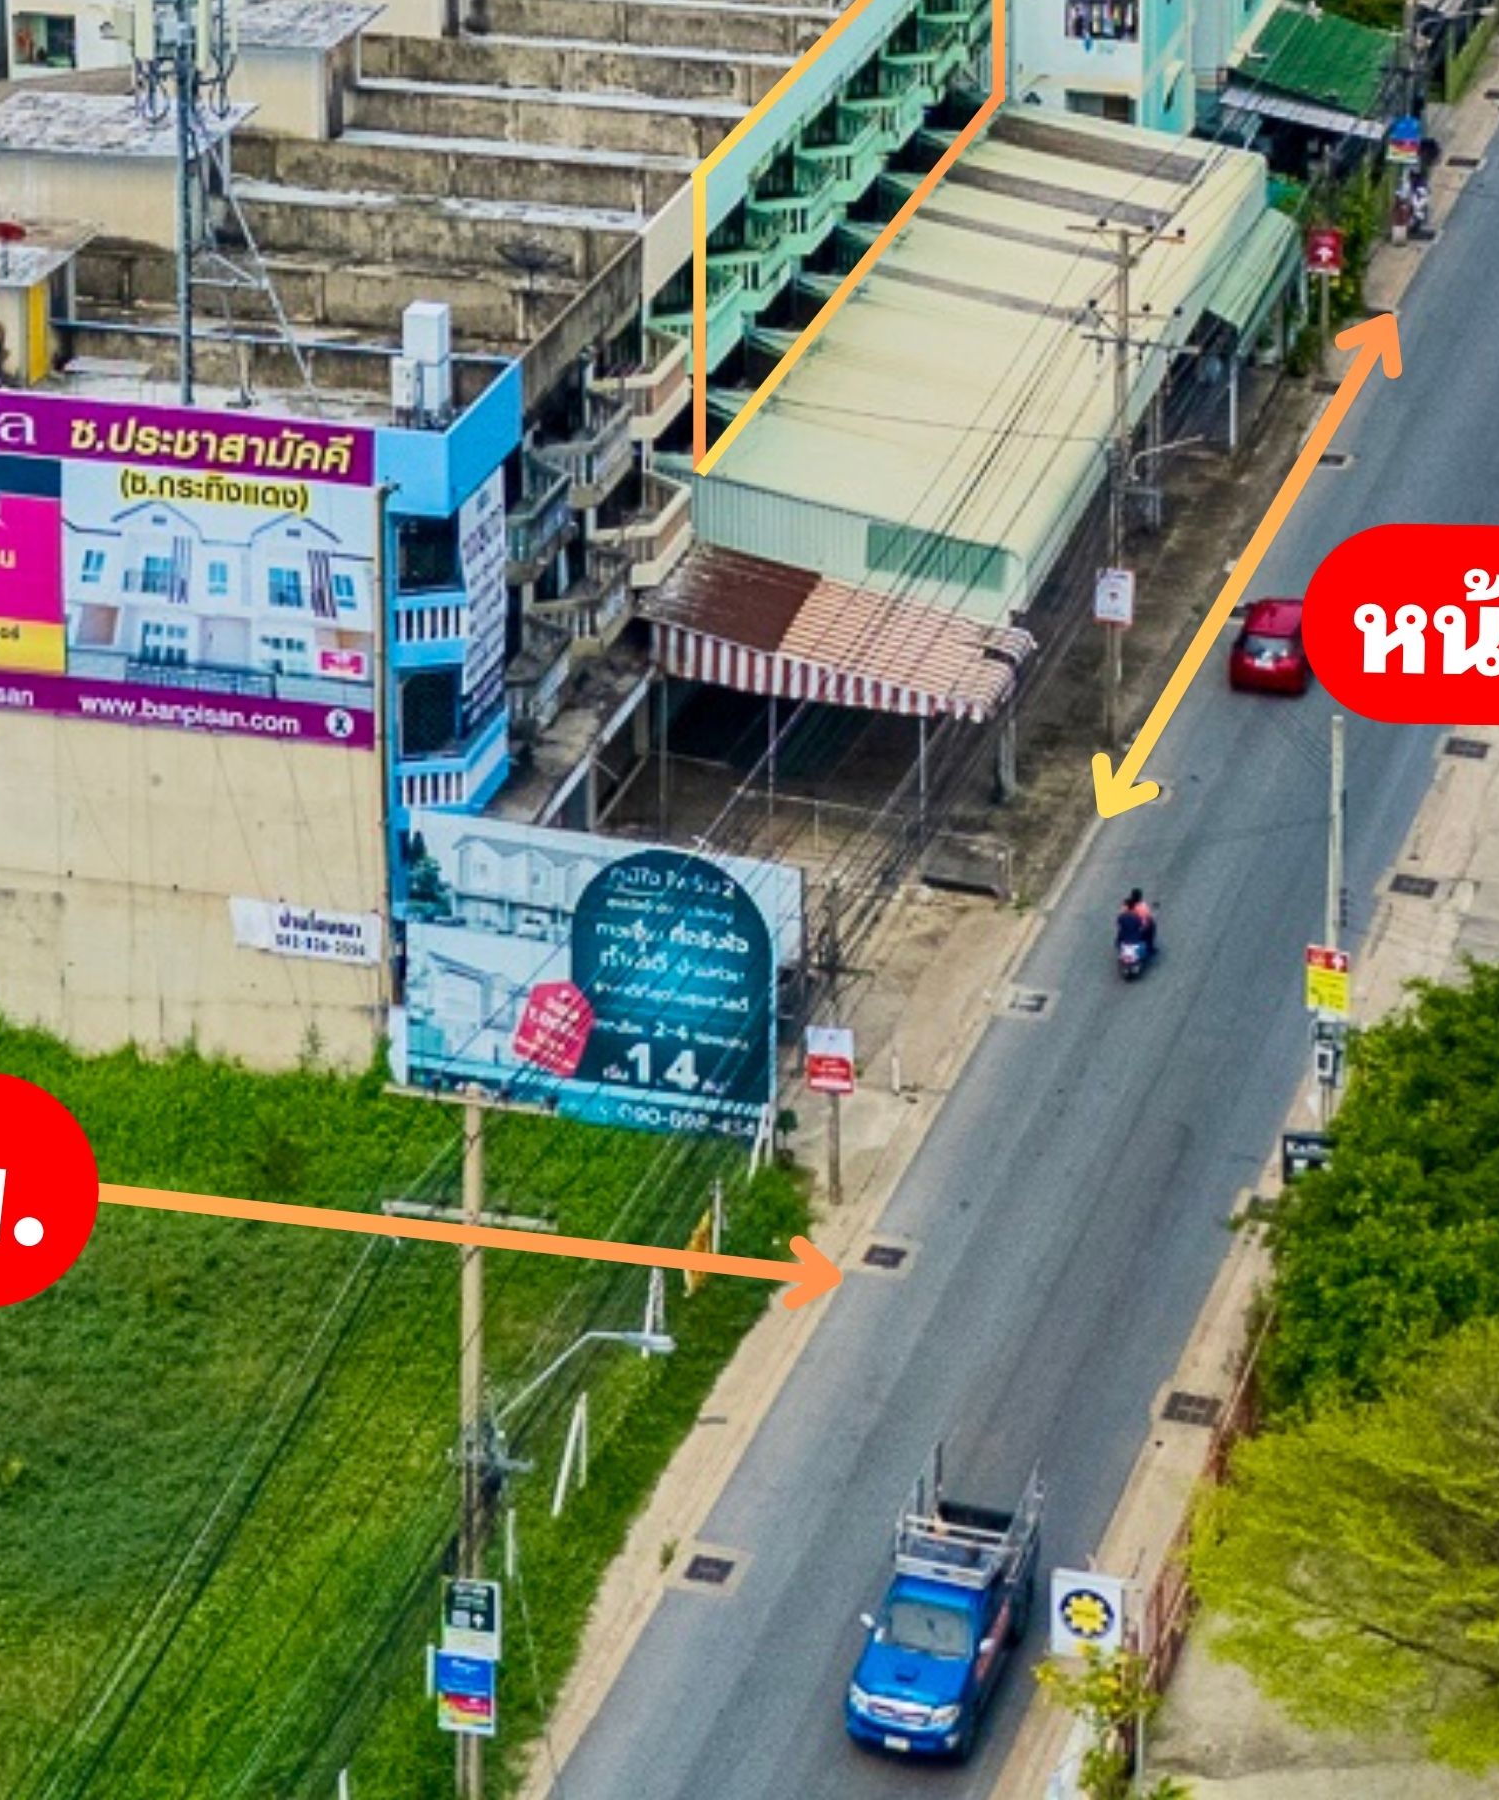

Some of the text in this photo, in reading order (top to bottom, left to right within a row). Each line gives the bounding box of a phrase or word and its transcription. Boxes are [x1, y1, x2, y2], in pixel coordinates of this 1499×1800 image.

[70, 417, 354, 474] ซ.ประชาสามัคคี
[78, 695, 300, 734] www.banpisan.com
